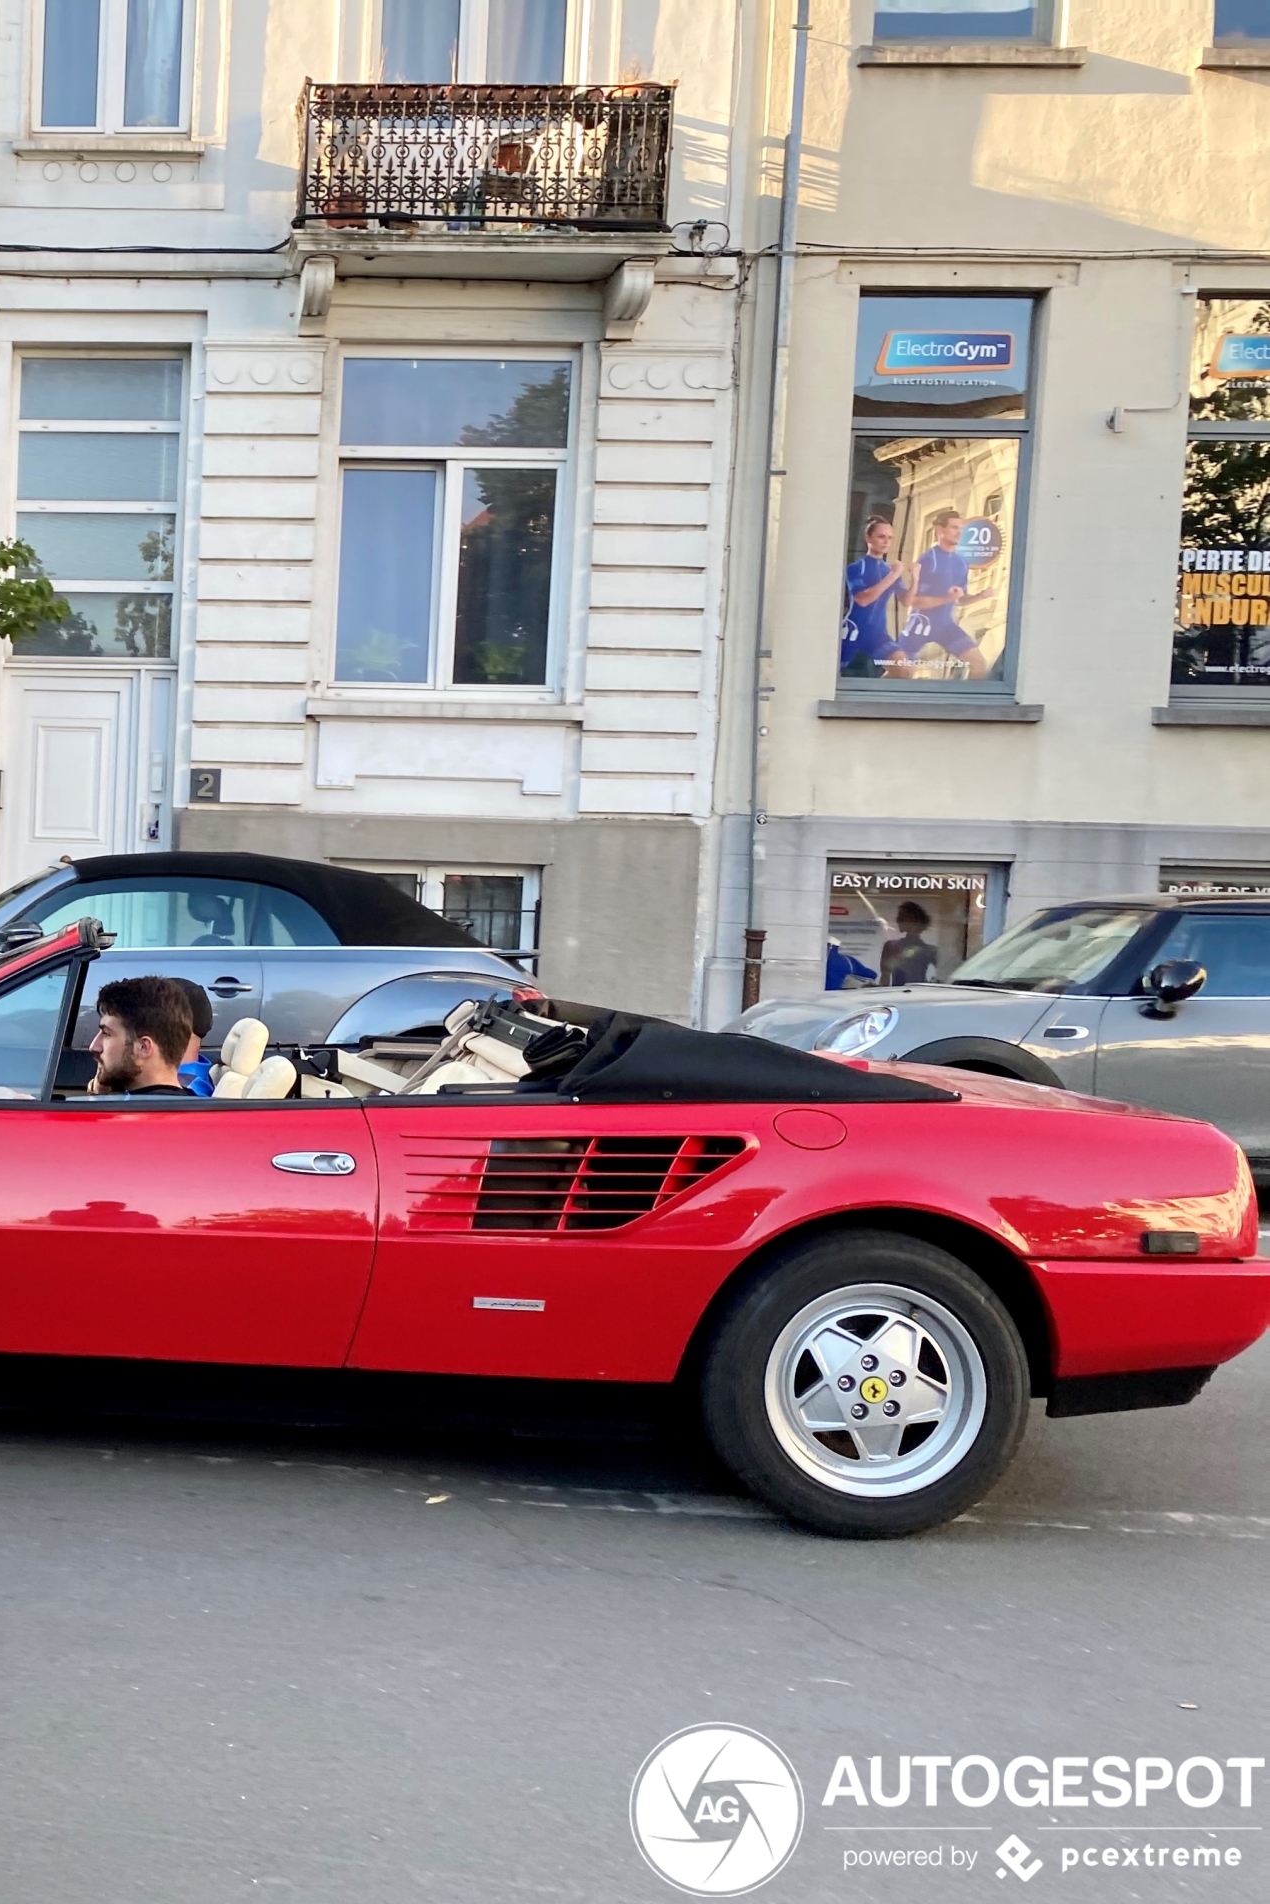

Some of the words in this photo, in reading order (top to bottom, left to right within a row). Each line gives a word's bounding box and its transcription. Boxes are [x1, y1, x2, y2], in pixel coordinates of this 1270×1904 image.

[892, 377, 997, 387] ELECTROSTIMULATION
[967, 526, 992, 545] 20
[1182, 550, 1244, 572] PERTE
[1247, 550, 1270, 571] DE
[1182, 573, 1270, 597] MUSCUL
[1180, 598, 1270, 626] ENDUR
[873, 657, 971, 669] www.electrogym.be
[197, 773, 215, 798] 2
[832, 875, 872, 888] EASY
[875, 876, 943, 890] MOTION
[947, 878, 985, 890] SKIN
